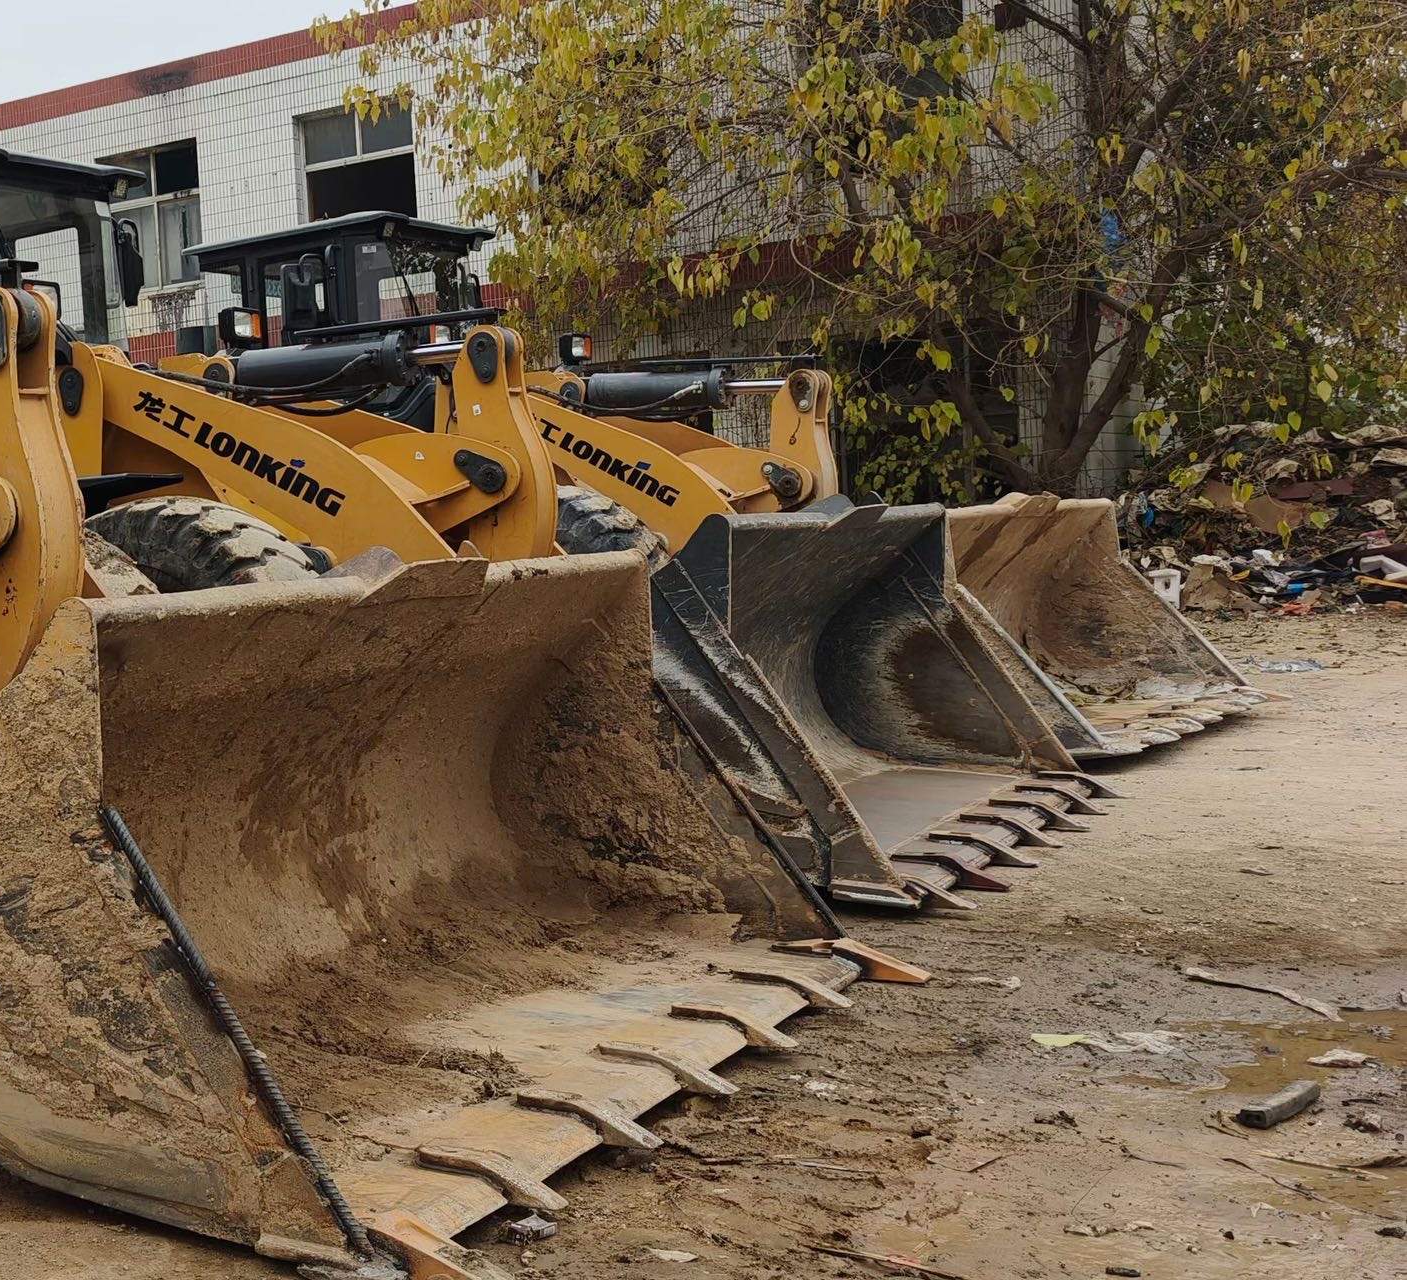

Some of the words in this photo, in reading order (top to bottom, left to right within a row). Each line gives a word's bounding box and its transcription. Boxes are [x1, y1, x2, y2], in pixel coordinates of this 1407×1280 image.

[133, 390, 196, 438] 龙工
[194, 421, 346, 517] LONKING
[559, 432, 681, 507] LONKING
